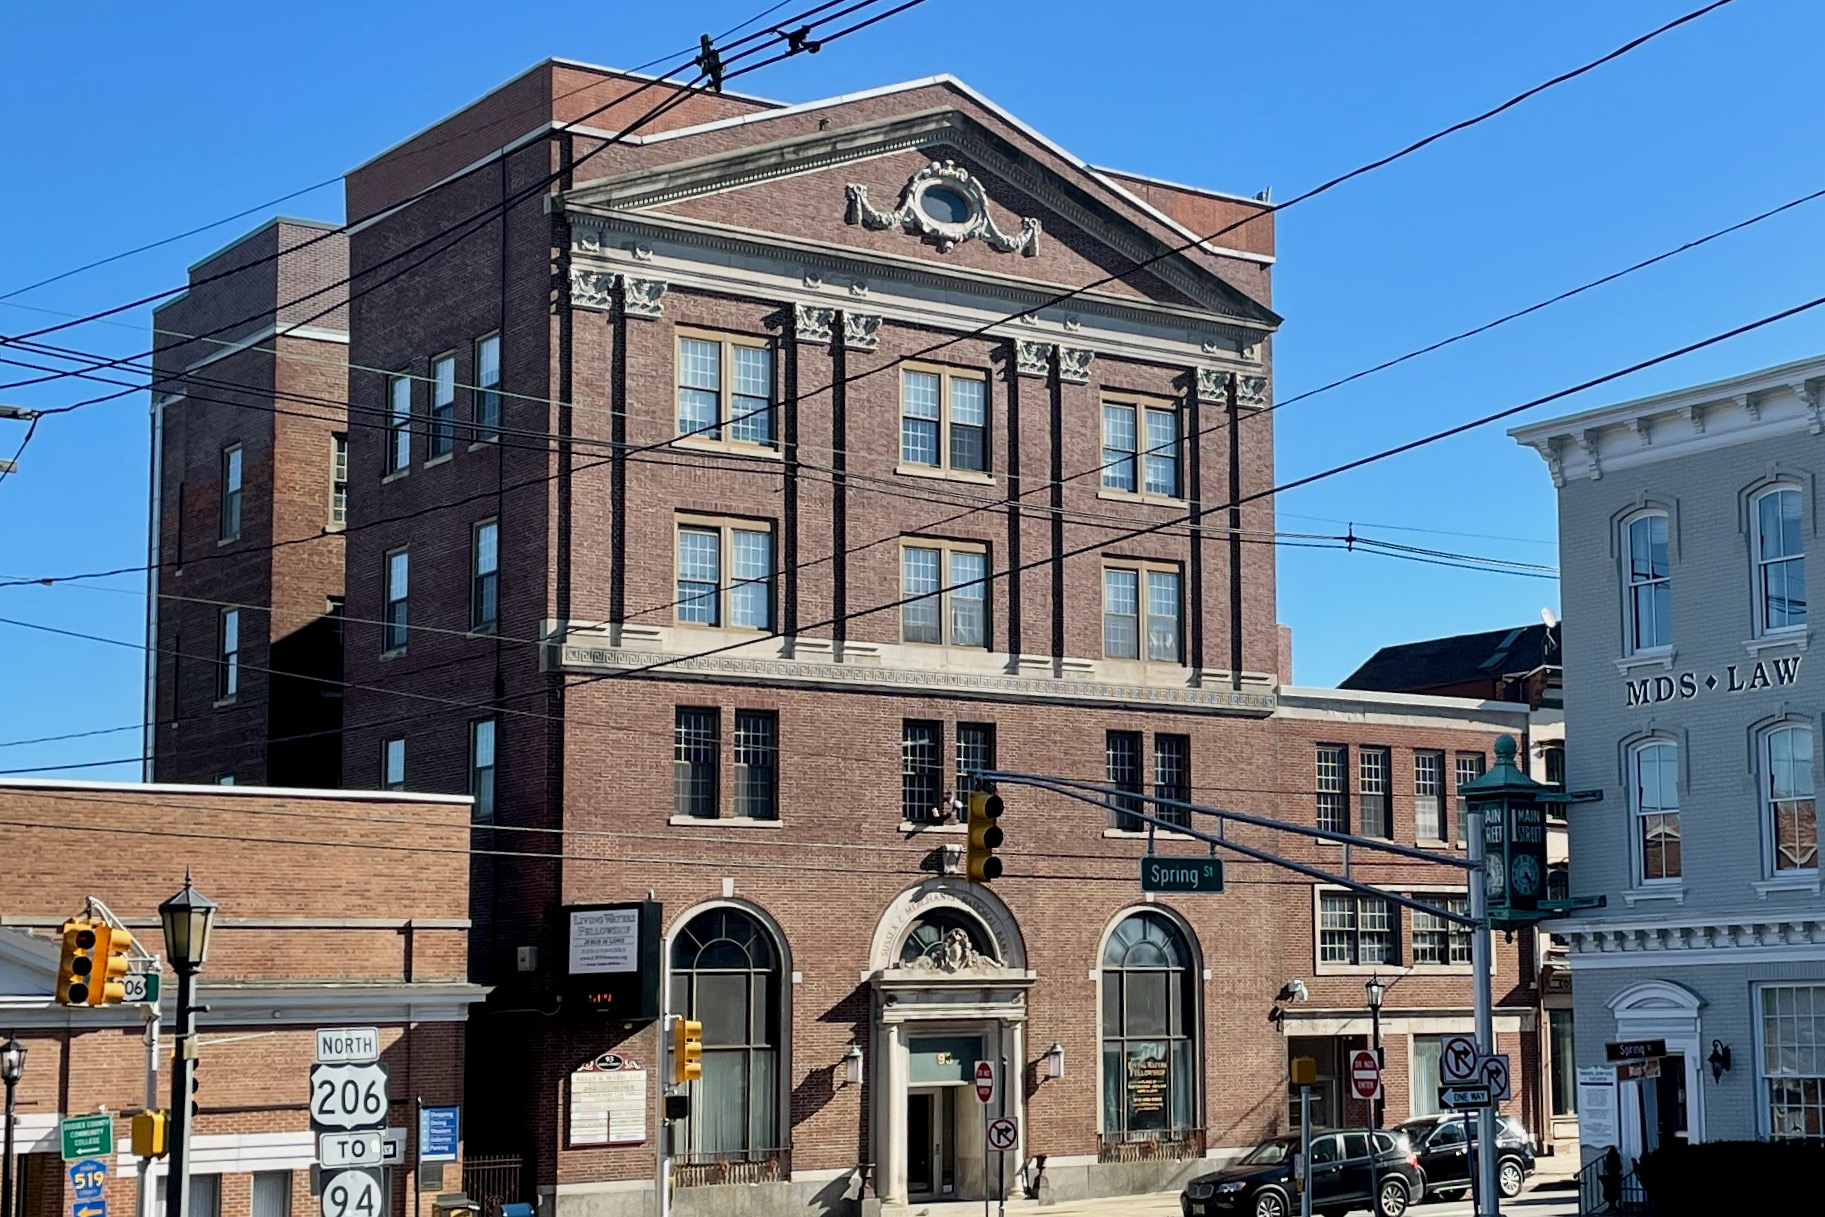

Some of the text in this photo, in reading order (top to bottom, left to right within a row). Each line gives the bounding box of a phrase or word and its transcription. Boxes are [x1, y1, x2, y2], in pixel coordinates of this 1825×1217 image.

[1626, 656, 1802, 707] MDS LAW
[1485, 808, 1501, 825] AIN
[1518, 809, 1540, 823] MAIN
[1518, 826, 1541, 843] STREET
[1151, 864, 1214, 889] Spring St
[577, 926, 632, 937] FELLOWSHIP
[880, 924, 899, 957] SUSSEX
[119, 980, 144, 996] 06
[322, 1037, 373, 1055] NORTH
[1619, 1044, 1645, 1056] Spring
[1354, 1060, 1375, 1069] DO NOT
[1357, 1080, 1375, 1090] ENTER
[317, 1079, 381, 1115] 206
[1454, 1091, 1486, 1102] ONE WAY
[337, 1139, 366, 1158] TO
[75, 1171, 104, 1189] 519
[330, 1182, 374, 1217] 94
